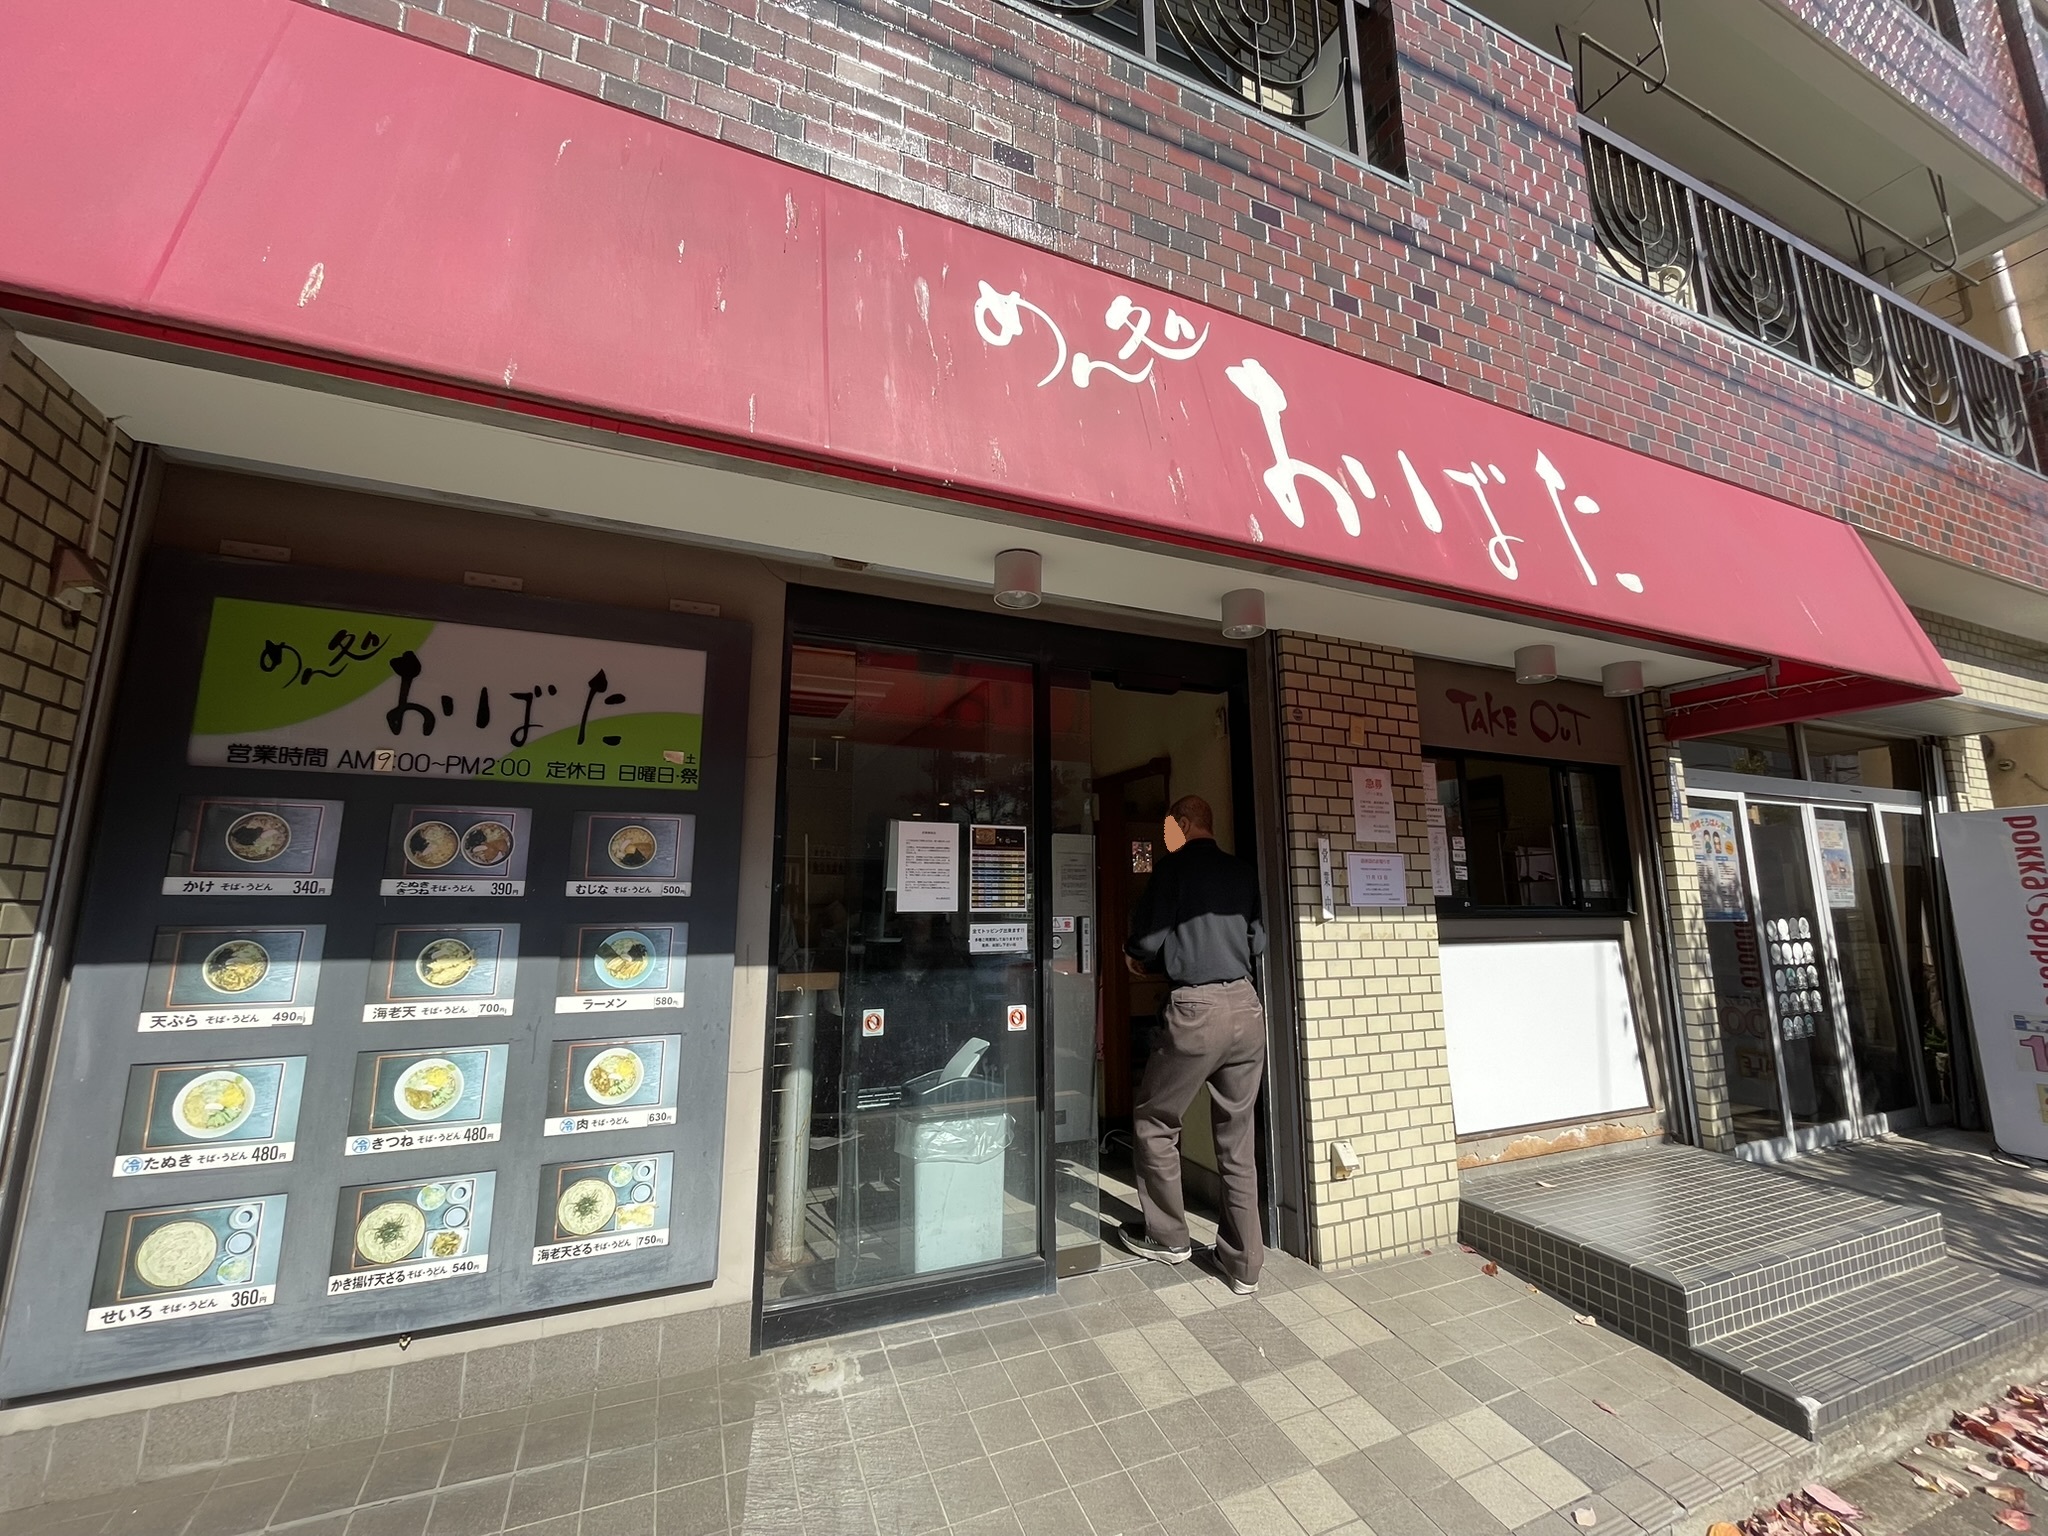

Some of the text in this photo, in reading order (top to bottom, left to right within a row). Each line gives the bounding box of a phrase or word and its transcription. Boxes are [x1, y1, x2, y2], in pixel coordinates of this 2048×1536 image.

[1225, 358, 1643, 593] おばた
[386, 651, 626, 747] おばた
[227, 743, 328, 768] 営業時間
[546, 761, 606, 780] 定休日
[182, 880, 215, 892] かけ
[293, 880, 325, 894] 340円
[490, 882, 519, 895] 390円
[575, 884, 608, 895] むじな
[583, 998, 627, 1010] ラーメン
[150, 1014, 198, 1028] 天ぷら
[372, 1006, 417, 1020] 海老天
[576, 1118, 589, 1131] 肉
[372, 1135, 414, 1150] きつね
[464, 1126, 494, 1142] 480円
[143, 1154, 192, 1171] たぬき
[251, 1145, 287, 1162] 480円
[537, 1243, 593, 1262] 海老天ざる
[100, 1305, 152, 1325] せいろ
[231, 1289, 267, 1308] 360円
